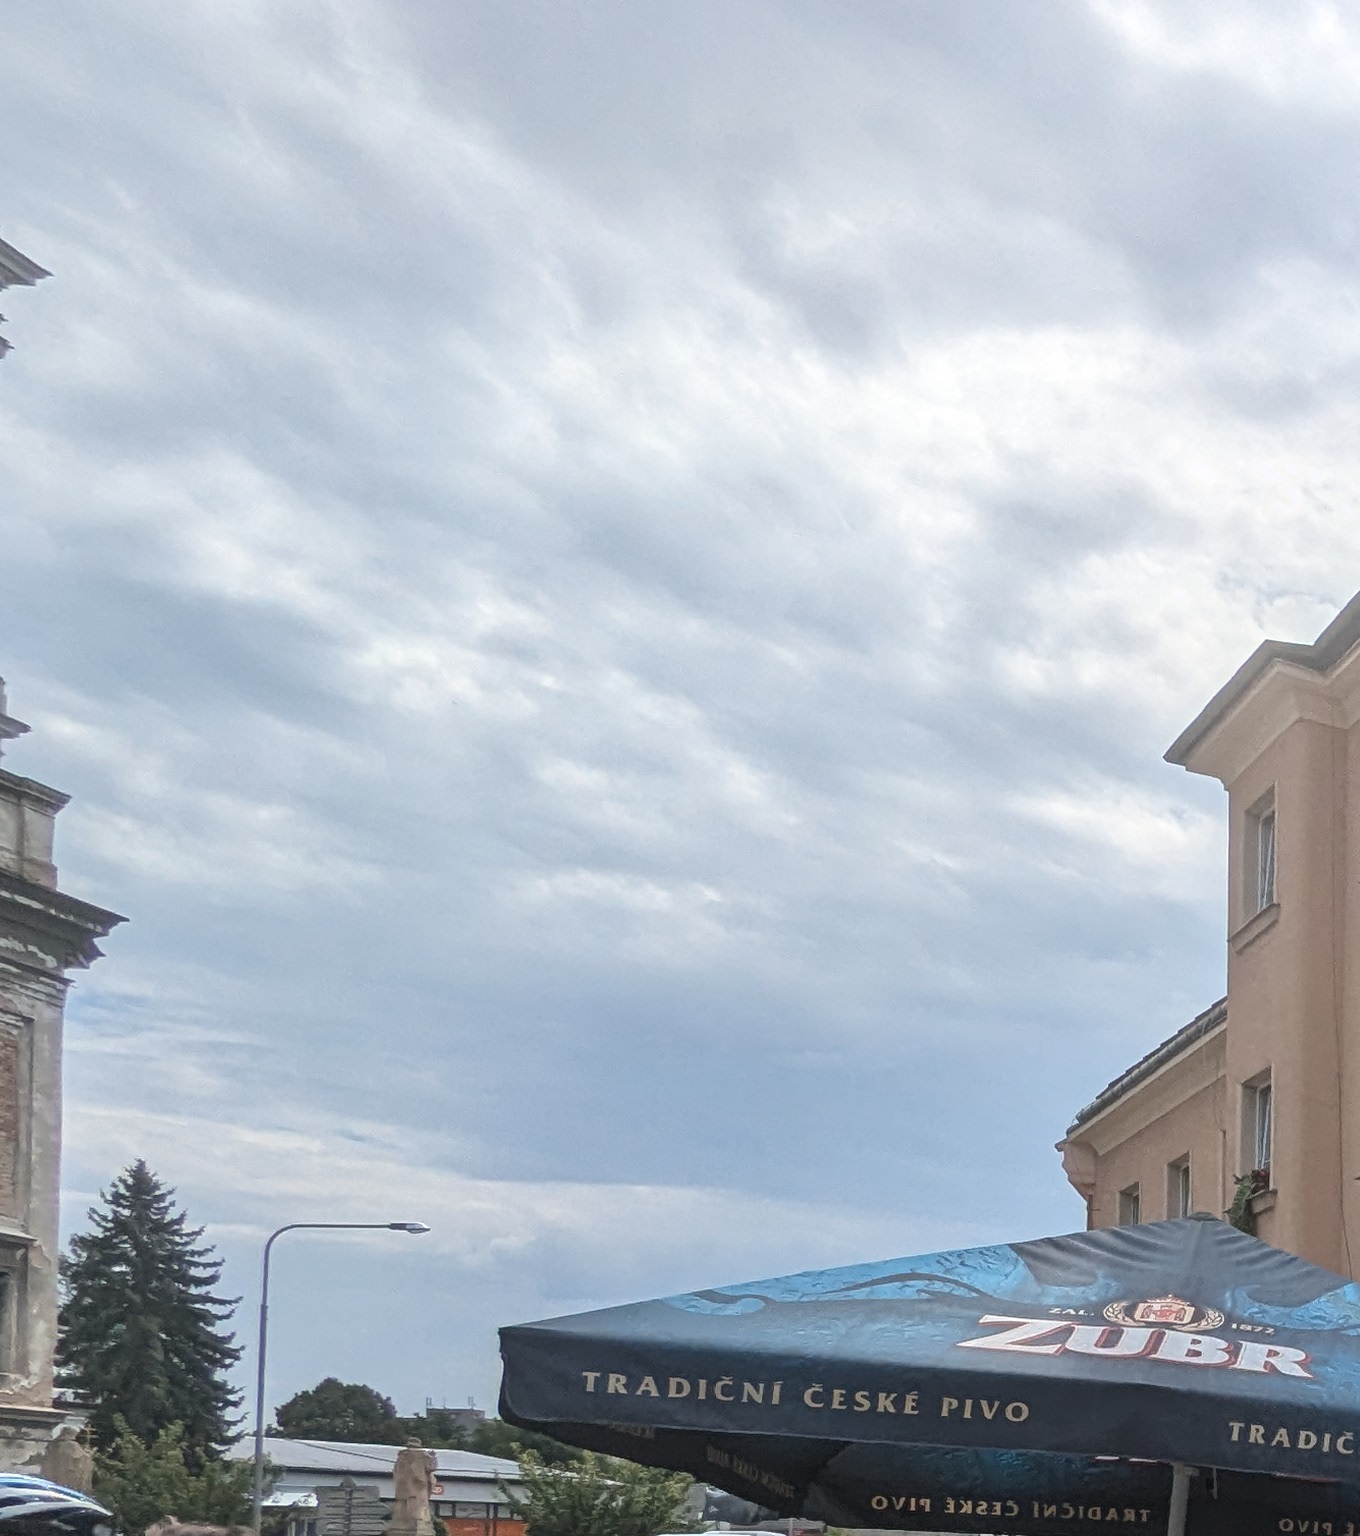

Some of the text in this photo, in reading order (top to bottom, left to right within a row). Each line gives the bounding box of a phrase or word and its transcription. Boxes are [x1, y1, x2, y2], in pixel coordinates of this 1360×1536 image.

[956, 1313, 1314, 1378] ZUBR
[582, 1370, 1031, 1424] TRADIČNÍ ČESKÉ PIVO
